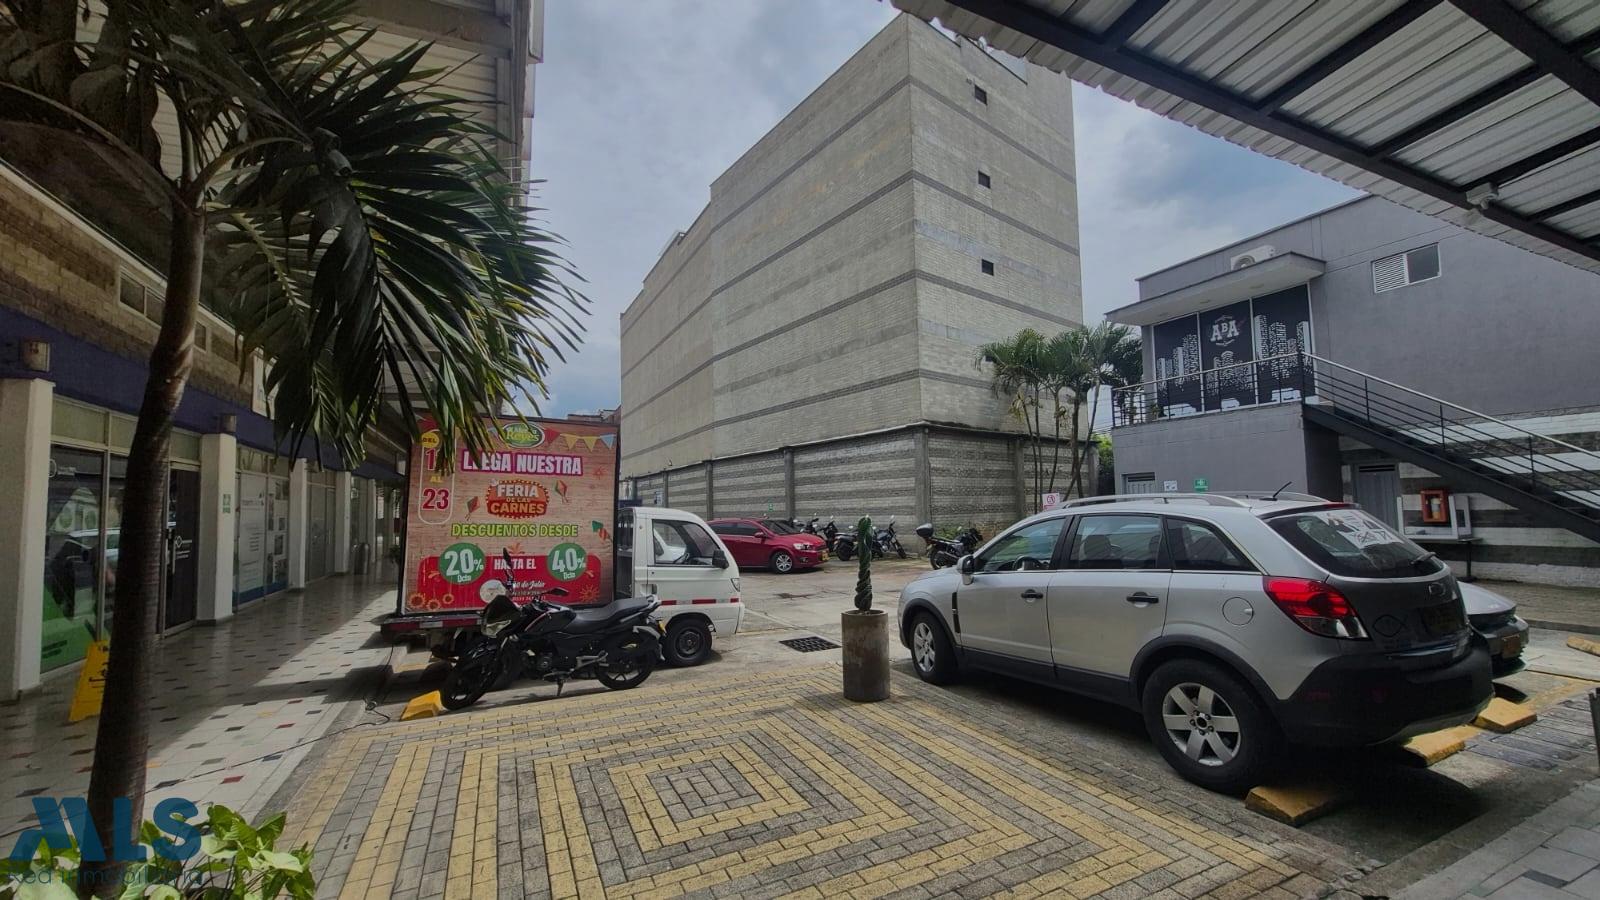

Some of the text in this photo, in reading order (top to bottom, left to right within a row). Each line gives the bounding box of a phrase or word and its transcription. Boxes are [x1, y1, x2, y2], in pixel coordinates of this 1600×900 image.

[1210, 320, 1239, 342] ABA
[516, 454, 582, 475] NUESTRA
[422, 488, 450, 510] 23
[497, 484, 539, 497] FERIA
[490, 502, 545, 514] CARNES
[451, 523, 579, 537] DESCUENTOS DESDE
[444, 548, 484, 576] 20%
[526, 559, 536, 570] EL
[552, 548, 586, 573] 40%
